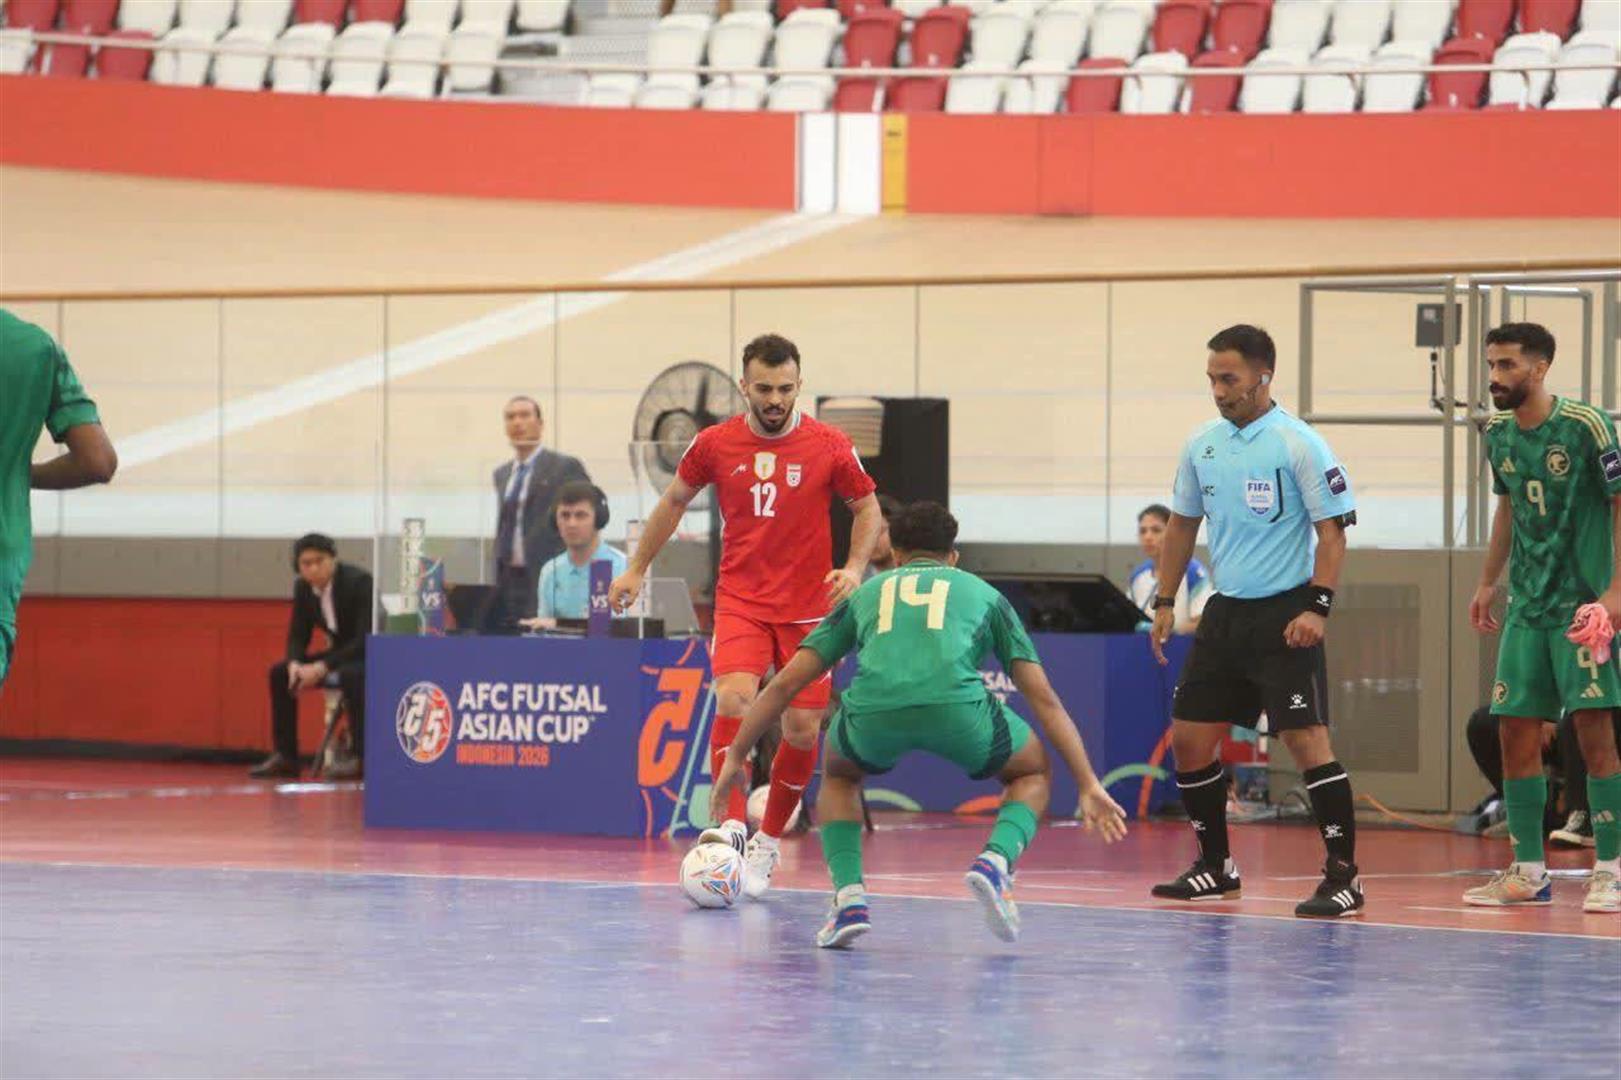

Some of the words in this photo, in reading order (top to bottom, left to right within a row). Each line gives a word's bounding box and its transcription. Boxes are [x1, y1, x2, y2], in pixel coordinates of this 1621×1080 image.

[750, 482, 777, 517] 12
[1247, 482, 1271, 492] FIFA
[1526, 480, 1546, 516] 9
[591, 596, 608, 609] VS
[876, 574, 951, 635] 14
[1577, 647, 1599, 679] 9
[457, 682, 508, 711] AFC
[512, 683, 608, 713] FUTSAL
[457, 713, 533, 741] ASIAN
[536, 715, 590, 743] CUP
[518, 745, 549, 767] 2026
